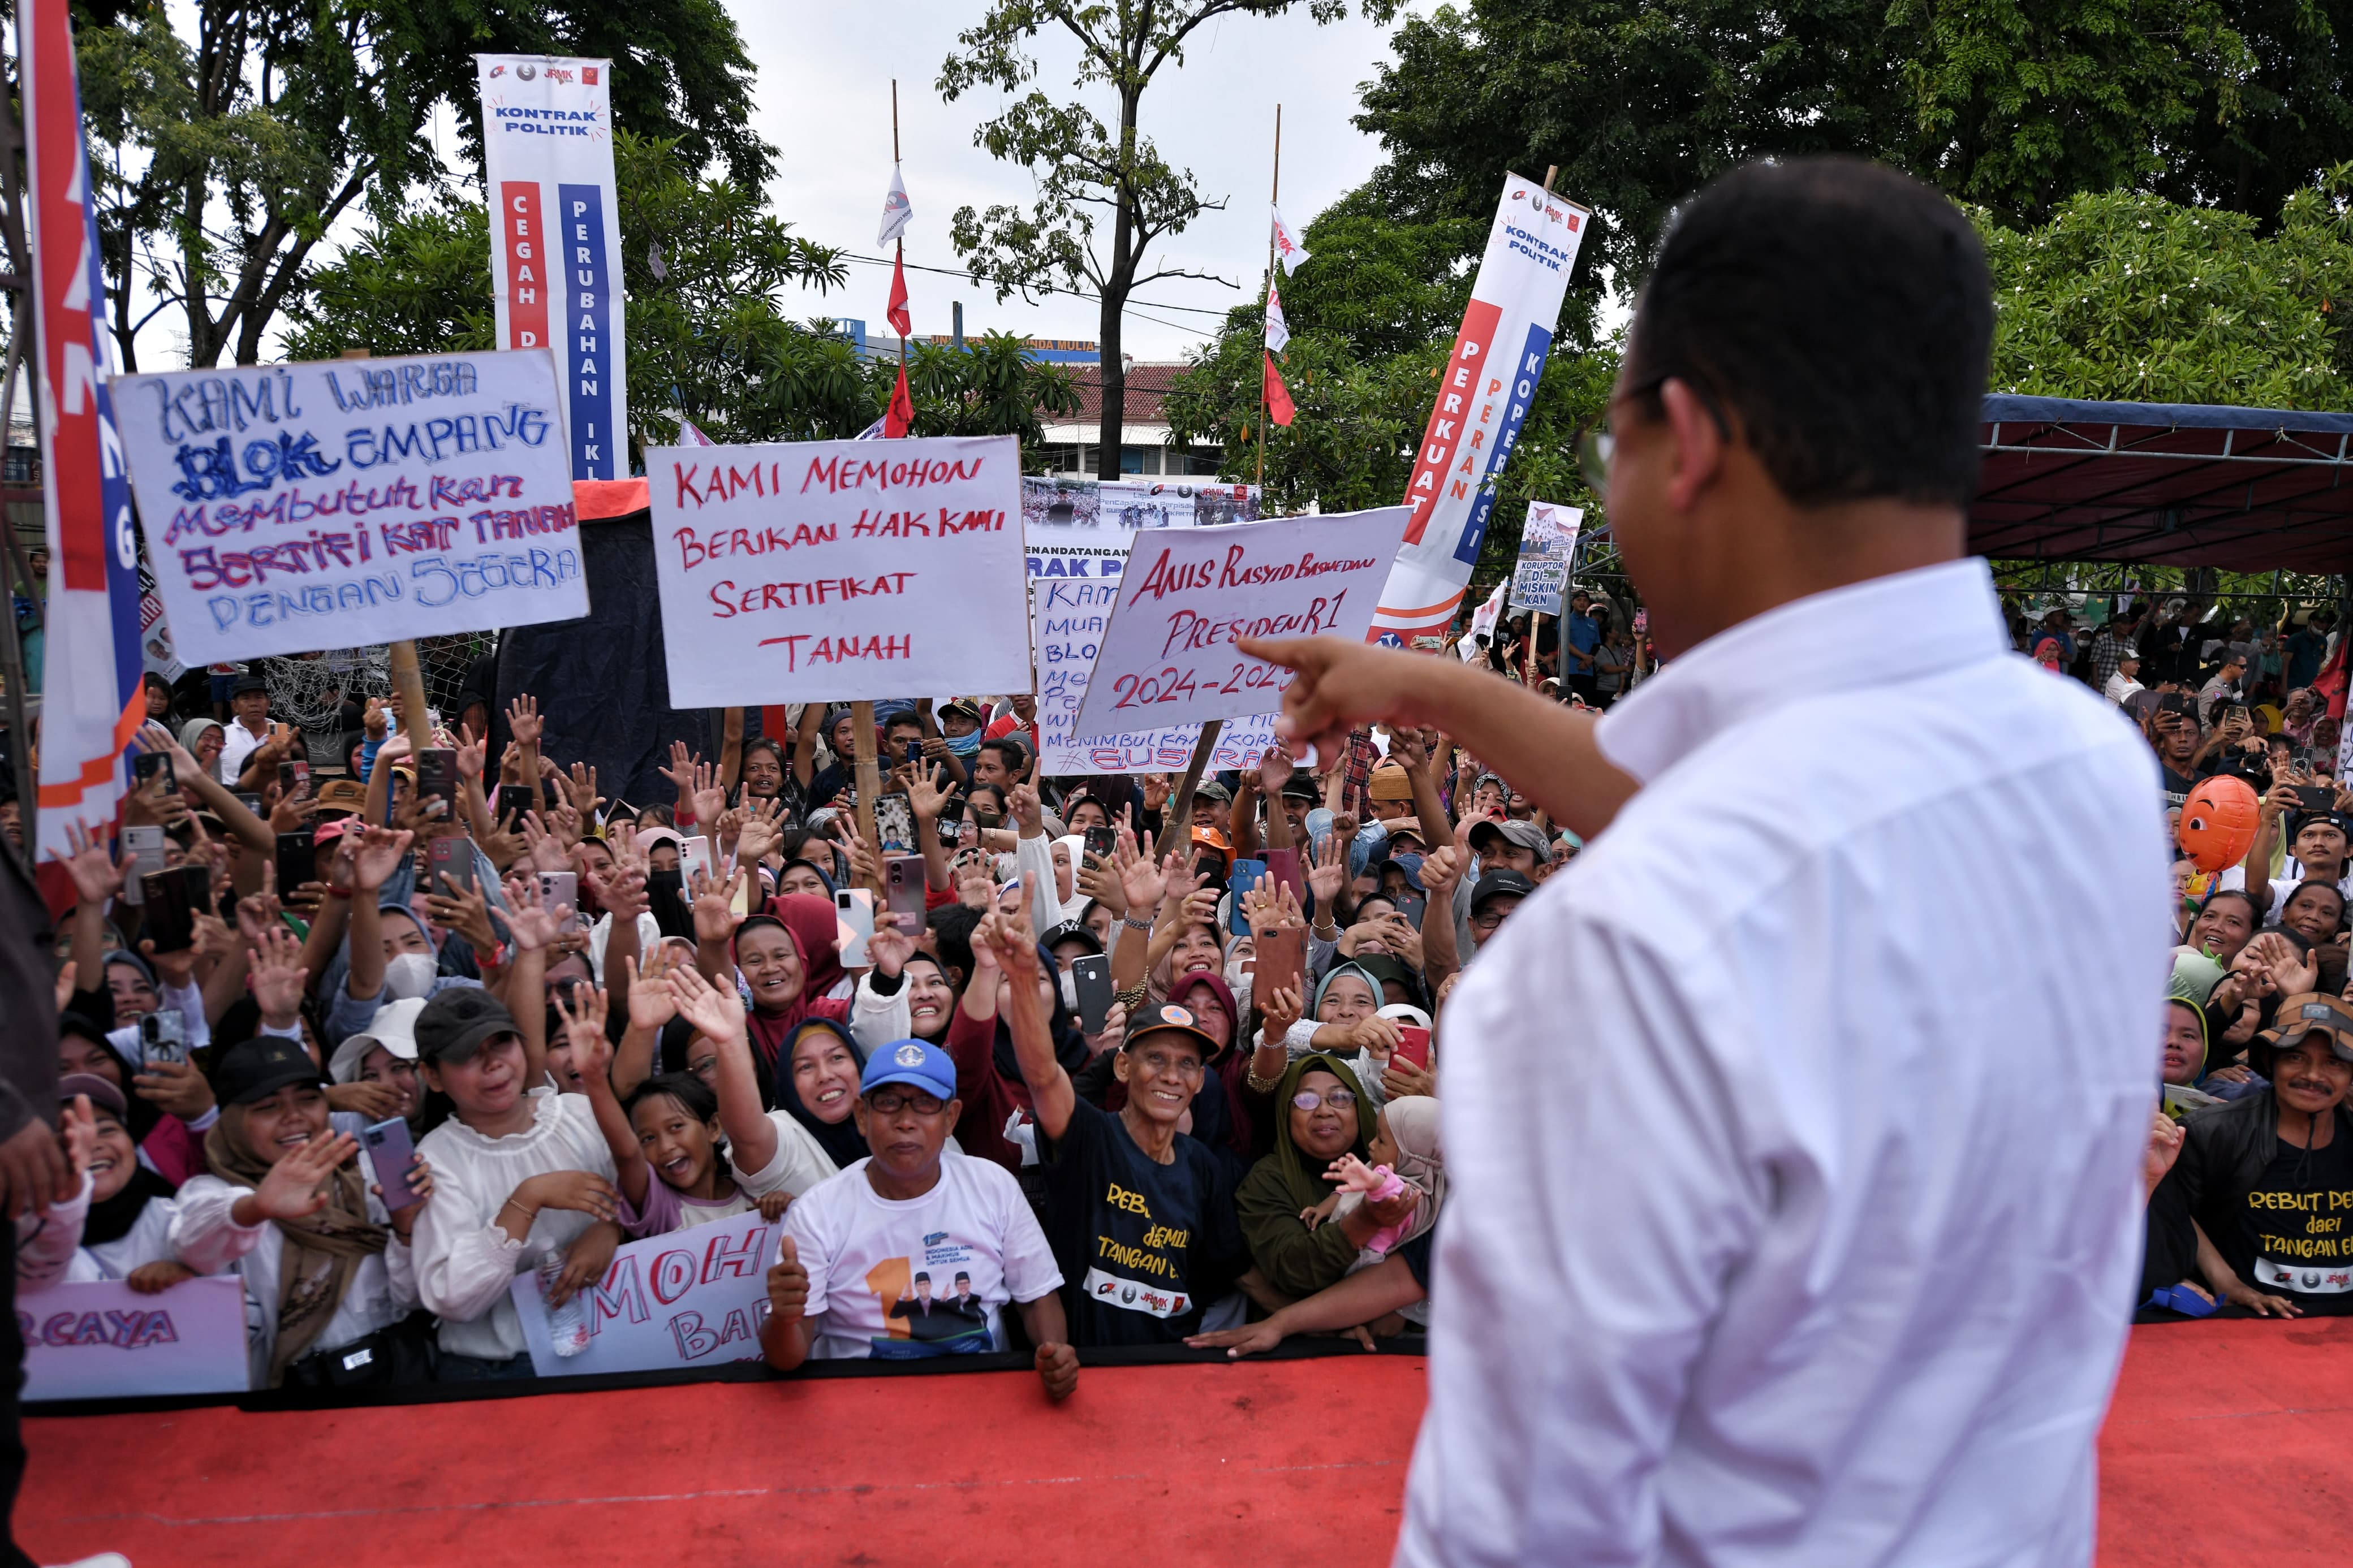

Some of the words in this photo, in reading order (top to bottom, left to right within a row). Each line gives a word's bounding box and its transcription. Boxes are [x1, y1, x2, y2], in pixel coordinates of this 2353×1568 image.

[496, 107, 597, 122] KONTRAK
[505, 122, 589, 136] POLITIK
[513, 196, 536, 304] CEGAH
[1506, 225, 1569, 263] KONTRAK
[1509, 240, 1561, 272] POLITIK
[572, 201, 598, 396] PERUBAHAN
[585, 422, 600, 481] IKL
[1022, 339, 1054, 349] UNDA
[1057, 340, 1094, 351] MULIA
[324, 362, 477, 413] WARGA
[1411, 340, 1480, 514] PERKUAT
[1449, 378, 1502, 501] PERAN
[171, 430, 342, 503] BLOK
[345, 401, 554, 471] EMPANG
[1468, 352, 1541, 547] KOPERASI
[673, 460, 779, 509] KAMI
[799, 455, 986, 495] MEMOHON
[467, 501, 579, 545] TANAH
[673, 522, 838, 572] BERIKAN
[851, 508, 930, 539] HAK
[938, 507, 1006, 538] KAMI
[1025, 546, 1131, 557] ENANDATANGAN
[1521, 560, 1565, 570] KORUPTOR
[206, 569, 406, 636] DENGAN
[411, 547, 583, 608] SEGERA
[708, 572, 919, 619] SERTIFIKAT
[1043, 580, 1119, 612] KAM
[1127, 547, 1216, 613] ANIS
[1217, 543, 1295, 590] RASYID
[1519, 582, 1558, 593] MISKIN
[1531, 571, 1548, 581] DI-
[1524, 594, 1548, 605] KAN
[757, 633, 911, 673] TANAH
[2248, 1191, 2324, 1211] REBUT
[2328, 1190, 2353, 1211] PE
[1097, 1235, 1167, 1276] TANGAN
[2259, 1233, 2338, 1258] TANGAN
